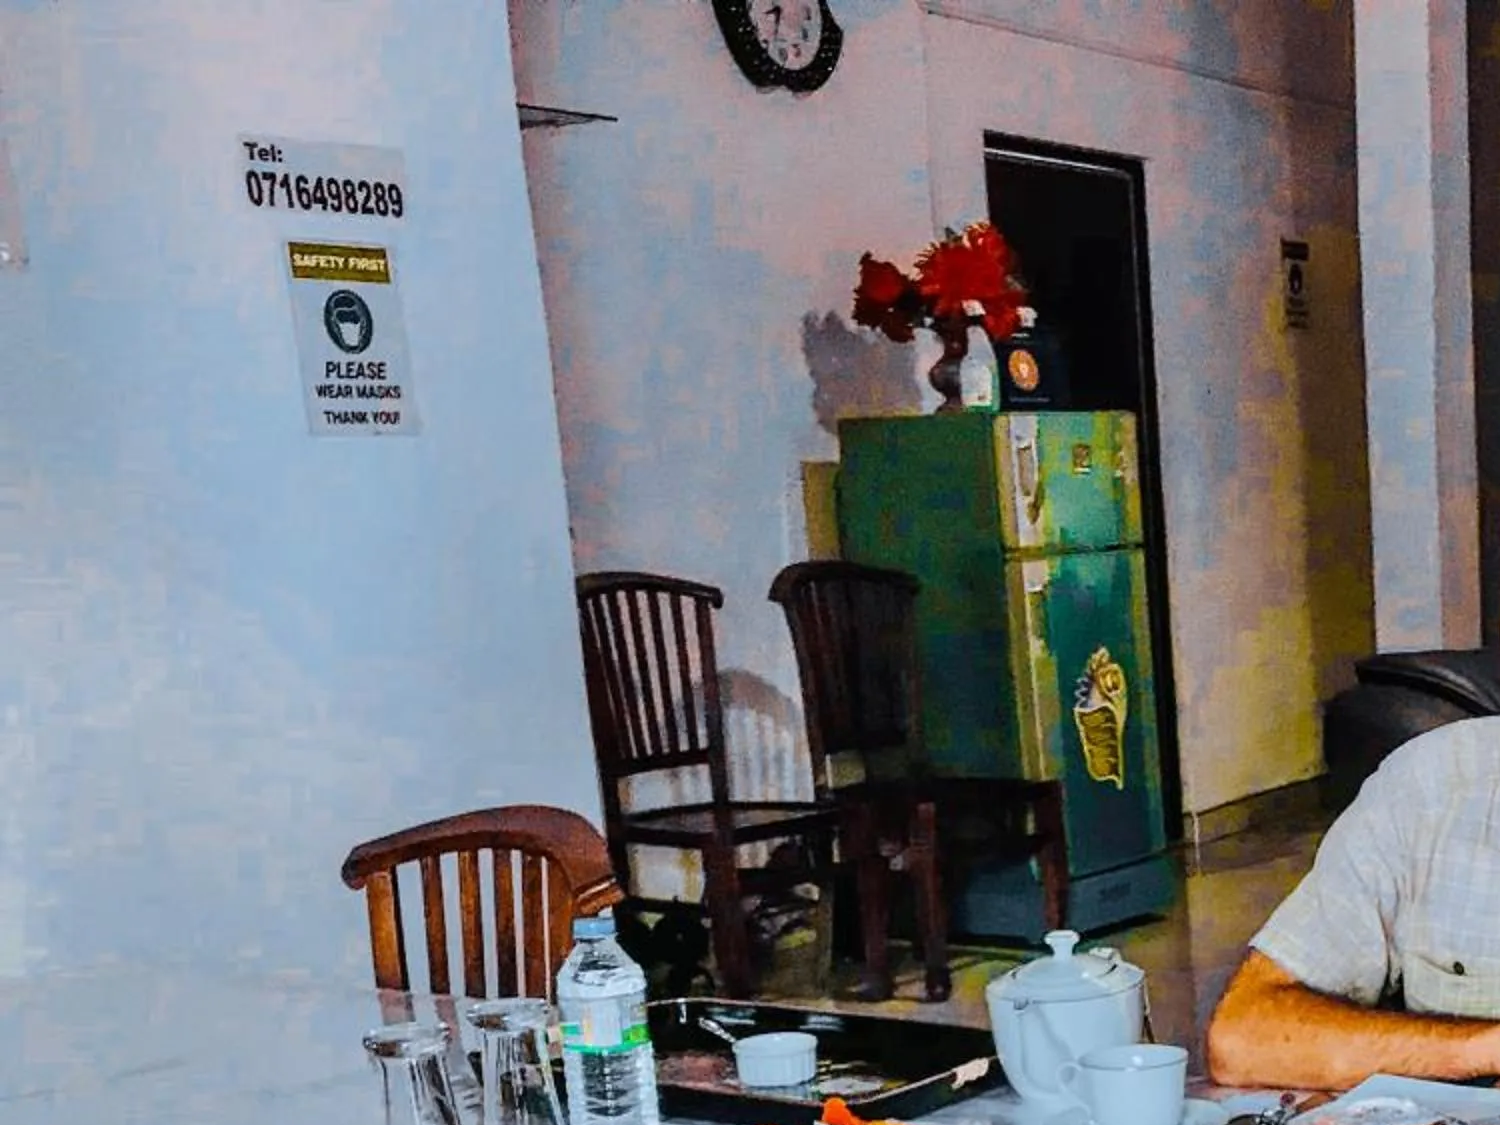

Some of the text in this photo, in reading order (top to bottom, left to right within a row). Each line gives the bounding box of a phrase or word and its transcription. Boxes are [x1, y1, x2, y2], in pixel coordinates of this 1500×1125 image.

[243, 142, 283, 163] Tel:
[246, 169, 403, 218] 0716498289
[293, 253, 385, 272] SAFETY FIRST
[325, 361, 387, 380] PLEASE
[315, 384, 401, 400] WEAR MASKS
[323, 410, 369, 425] THANK
